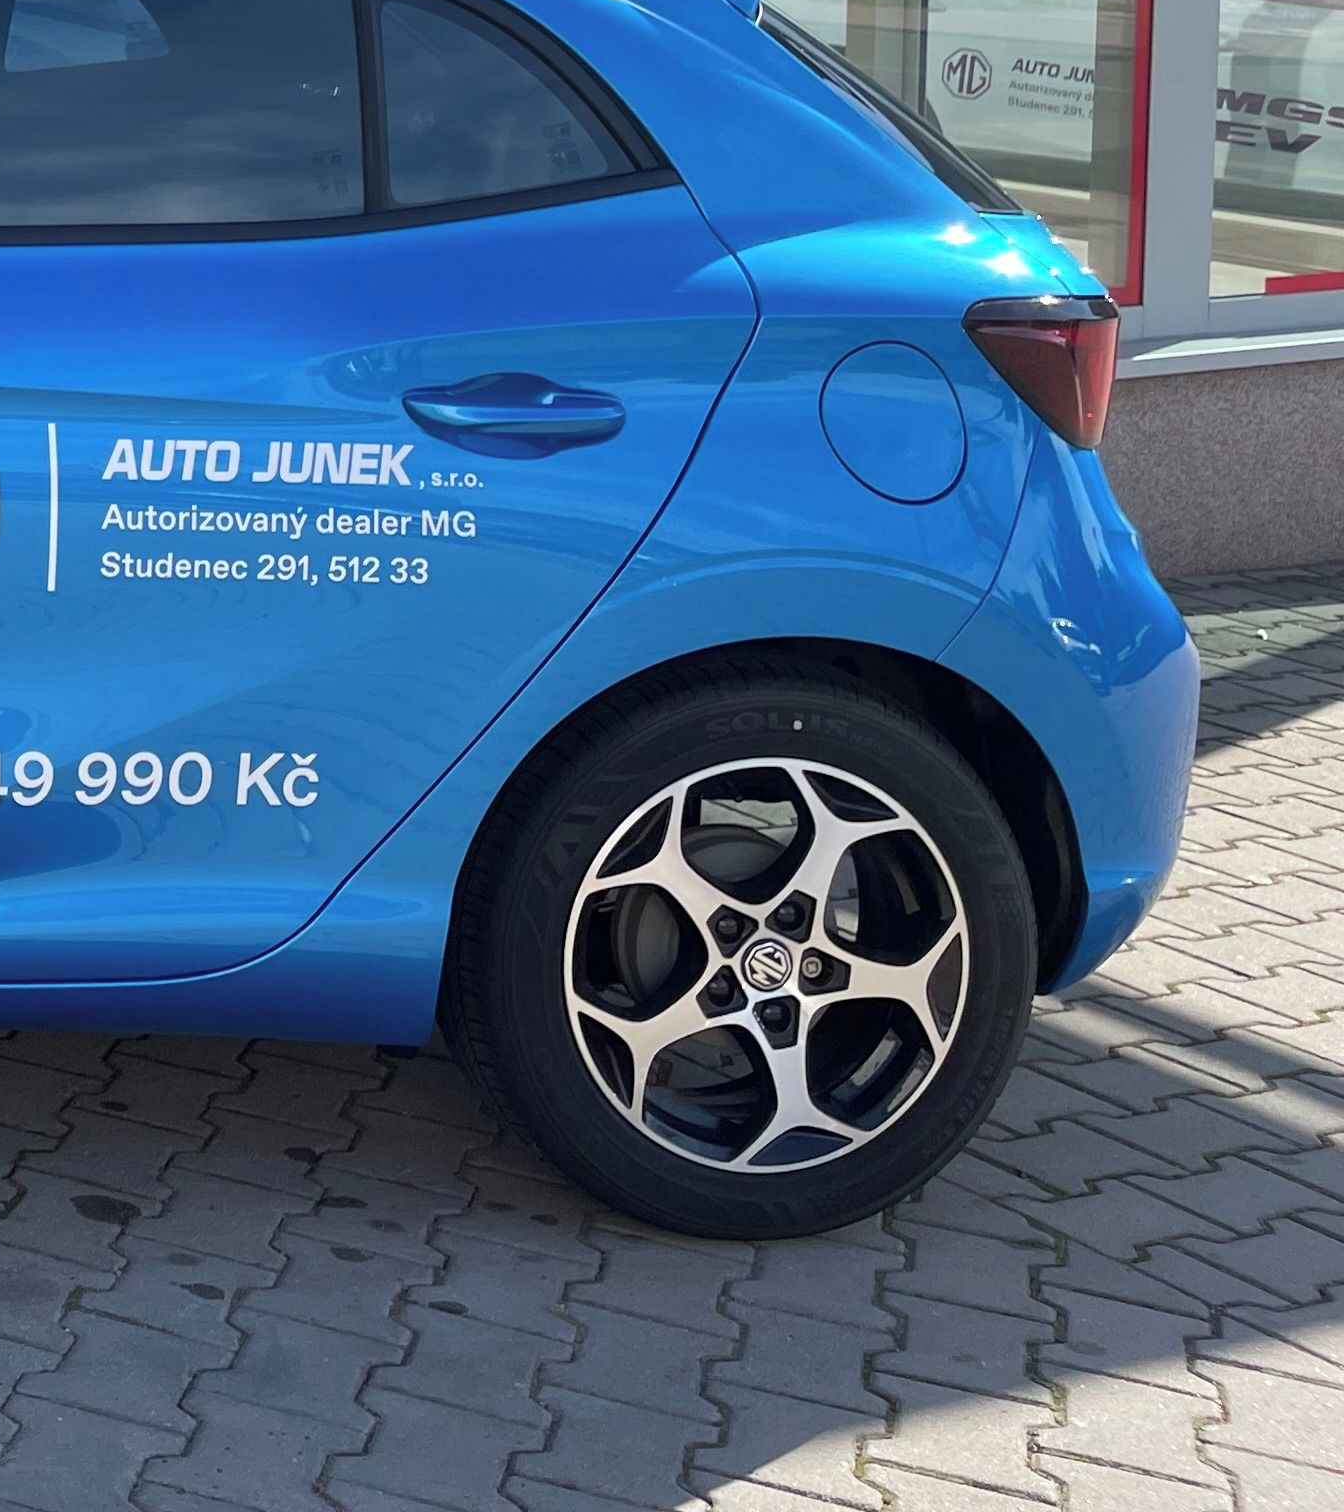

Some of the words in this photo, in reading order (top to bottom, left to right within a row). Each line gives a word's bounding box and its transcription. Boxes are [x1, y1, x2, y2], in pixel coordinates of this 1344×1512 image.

[945, 51, 989, 97] MG
[1012, 58, 1060, 78] AUTO
[1215, 120, 1322, 154] EV
[102, 438, 240, 484] AUTO
[101, 503, 307, 539] Autorizovaný
[316, 508, 412, 536] dealer
[421, 511, 476, 538] MG
[100, 553, 249, 581] Studenec
[256, 554, 319, 586] 291,
[327, 555, 380, 584] 512
[389, 557, 429, 586] 33
[75, 750, 213, 808] 990
[236, 751, 319, 808] Kč
